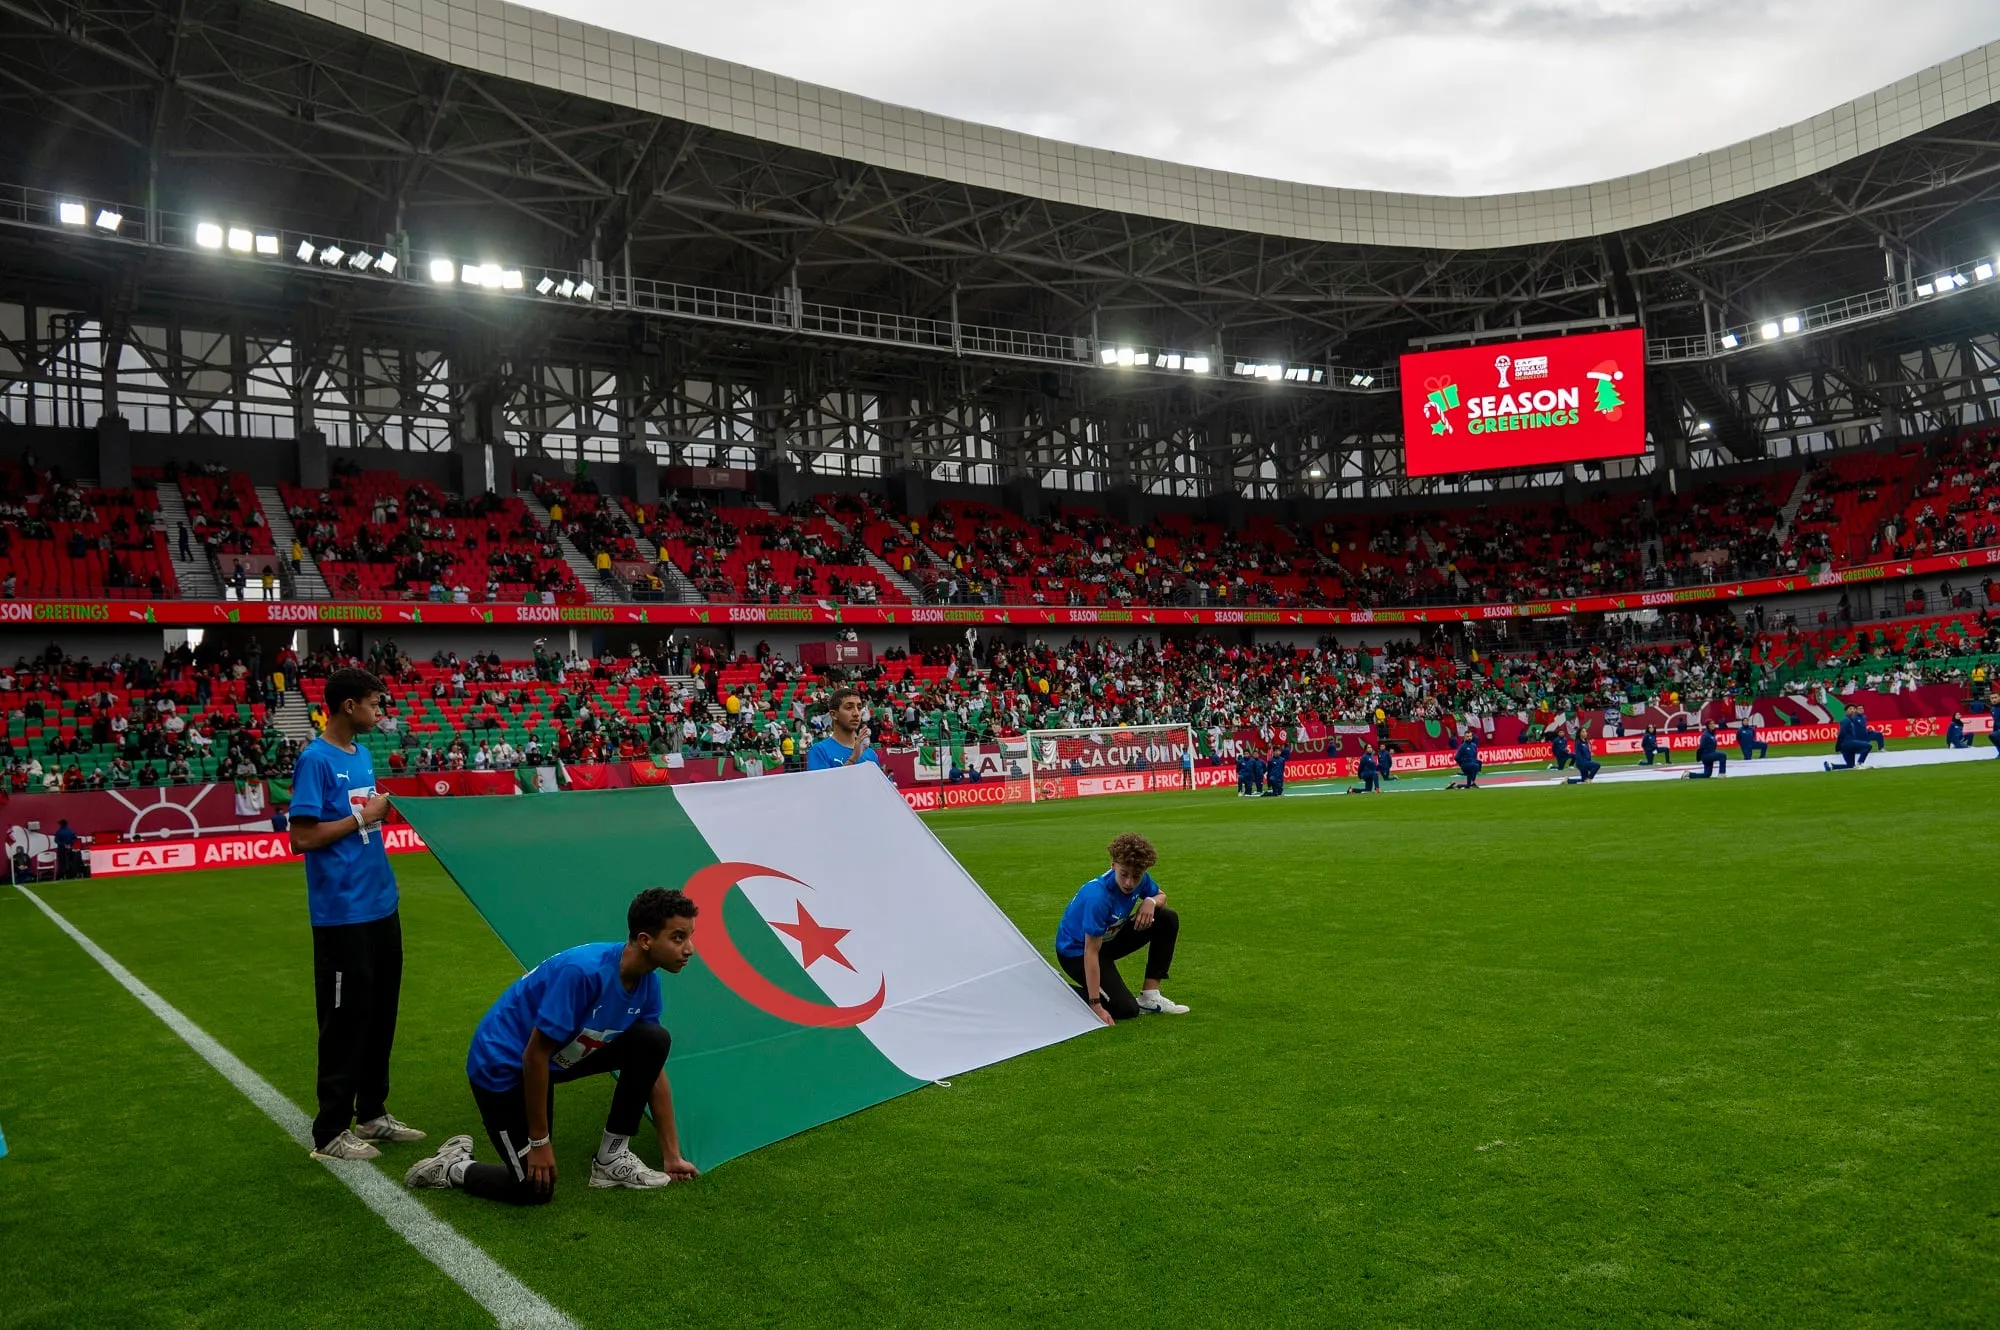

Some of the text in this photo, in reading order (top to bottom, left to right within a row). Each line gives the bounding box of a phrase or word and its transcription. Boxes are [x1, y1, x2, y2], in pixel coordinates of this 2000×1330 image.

[1467, 387, 1579, 419] SEASON
[1468, 409, 1579, 434] GREETINGS
[1843, 567, 1884, 581] GREETINGS
[1642, 588, 1716, 605] SEASON GREETINGS
[0, 603, 109, 620] SON GREETINGS
[268, 605, 382, 620] SEASON GREETINGS
[517, 607, 614, 621] SEASON GREETINGS
[729, 608, 813, 621] SEASON GREETINGS
[911, 609, 984, 621] SEASON GREETINGS
[1070, 610, 1133, 622] SEASON GREETINGS
[1214, 611, 1280, 623] SEASON GREETINGS
[1483, 606, 1512, 618] SEASON
[1716, 733, 1736, 746] CUP
[1756, 729, 1809, 743] NATIONS
[1396, 758, 1421, 769] CAF
[1477, 751, 1488, 762] OF
[1489, 747, 1523, 761] NATIONS
[1523, 746, 1553, 759] MOROC
[1102, 778, 1136, 791] CAF
[1212, 768, 1226, 784] OF
[1284, 763, 1324, 778] OROCCO
[1326, 762, 1336, 775] 25
[936, 786, 1005, 805] MOROCCO
[1008, 786, 1021, 799] 25
[112, 849, 180, 868] CAF
[204, 839, 287, 863] AFRICA
[627, 1007, 641, 1015] CA
